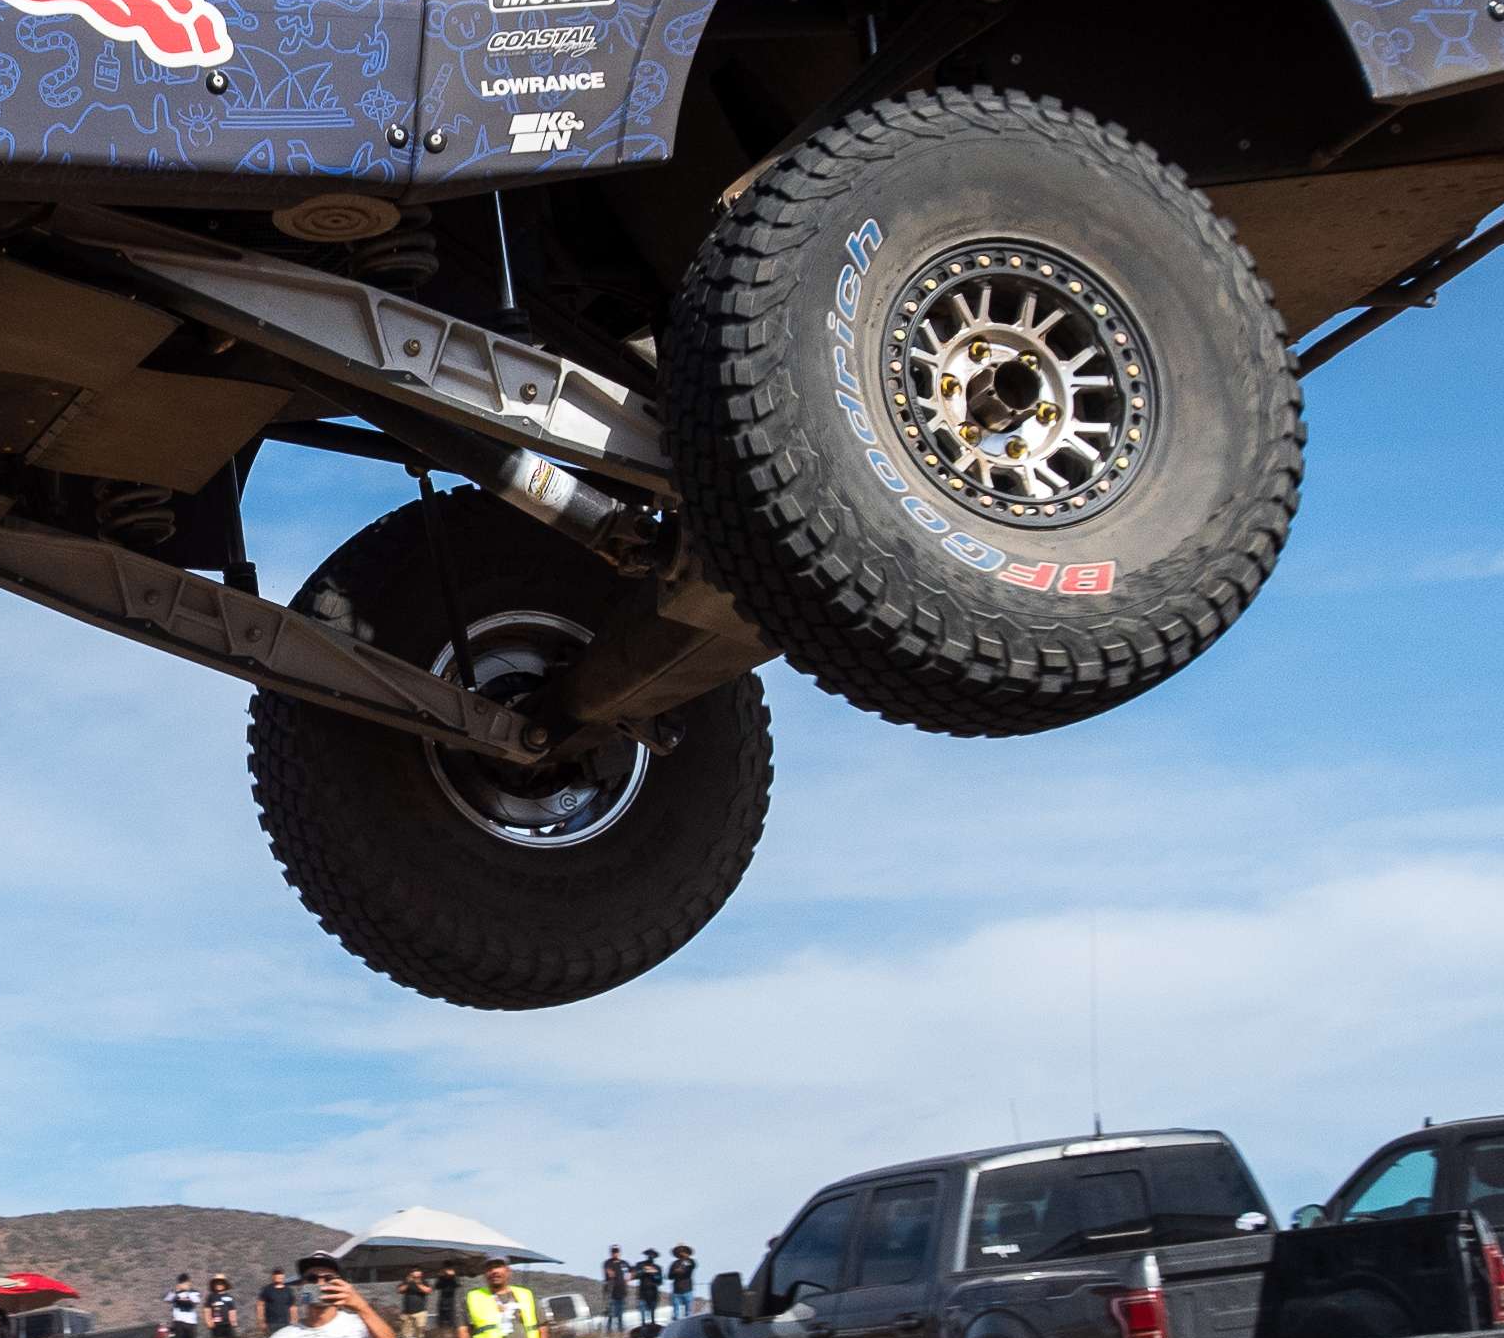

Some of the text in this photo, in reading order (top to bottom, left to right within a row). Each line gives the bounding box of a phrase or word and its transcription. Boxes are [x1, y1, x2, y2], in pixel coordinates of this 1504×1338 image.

[487, 26, 595, 52] COASTAL
[481, 72, 606, 97] LOWRANCE
[831, 217, 1117, 597] BFGoodrich
